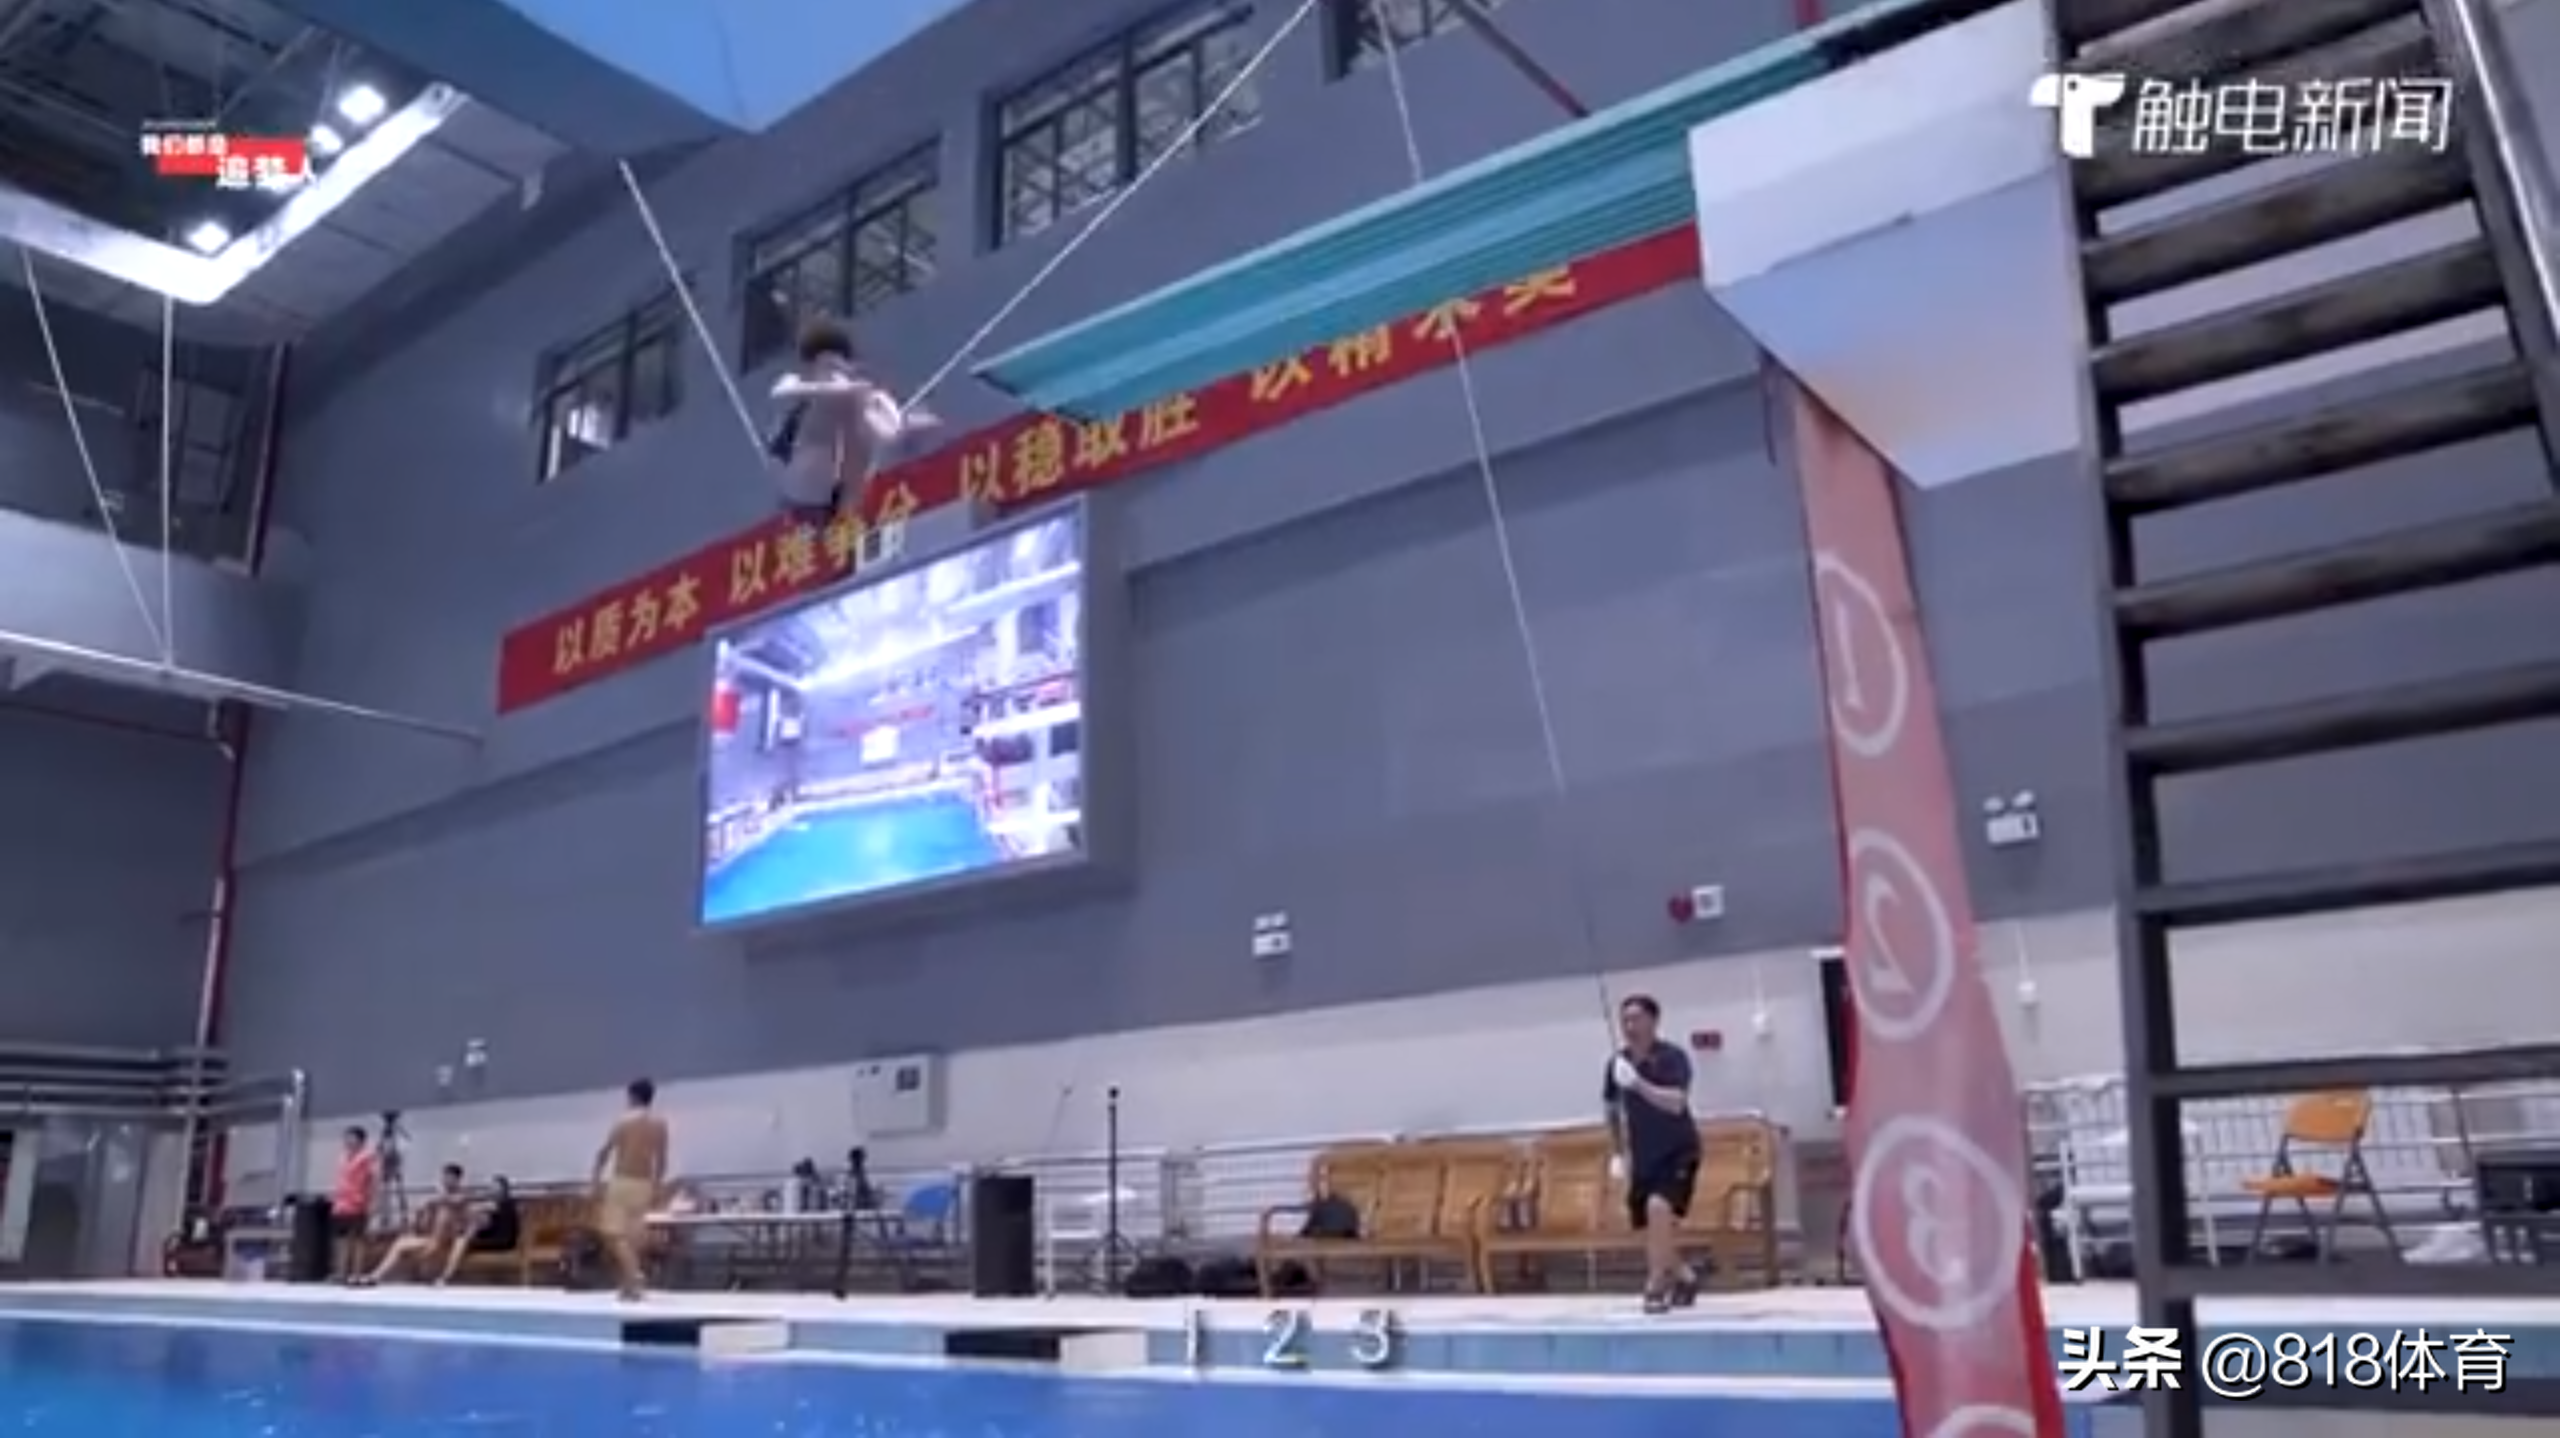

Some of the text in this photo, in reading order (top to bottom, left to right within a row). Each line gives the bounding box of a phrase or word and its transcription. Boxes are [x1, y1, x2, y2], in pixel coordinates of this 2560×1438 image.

[553, 570, 700, 674] 以质为本
[959, 391, 1199, 502] 以稳取胜
[1263, 1308, 1311, 1368] 2
[1351, 1308, 1401, 1369] 3
